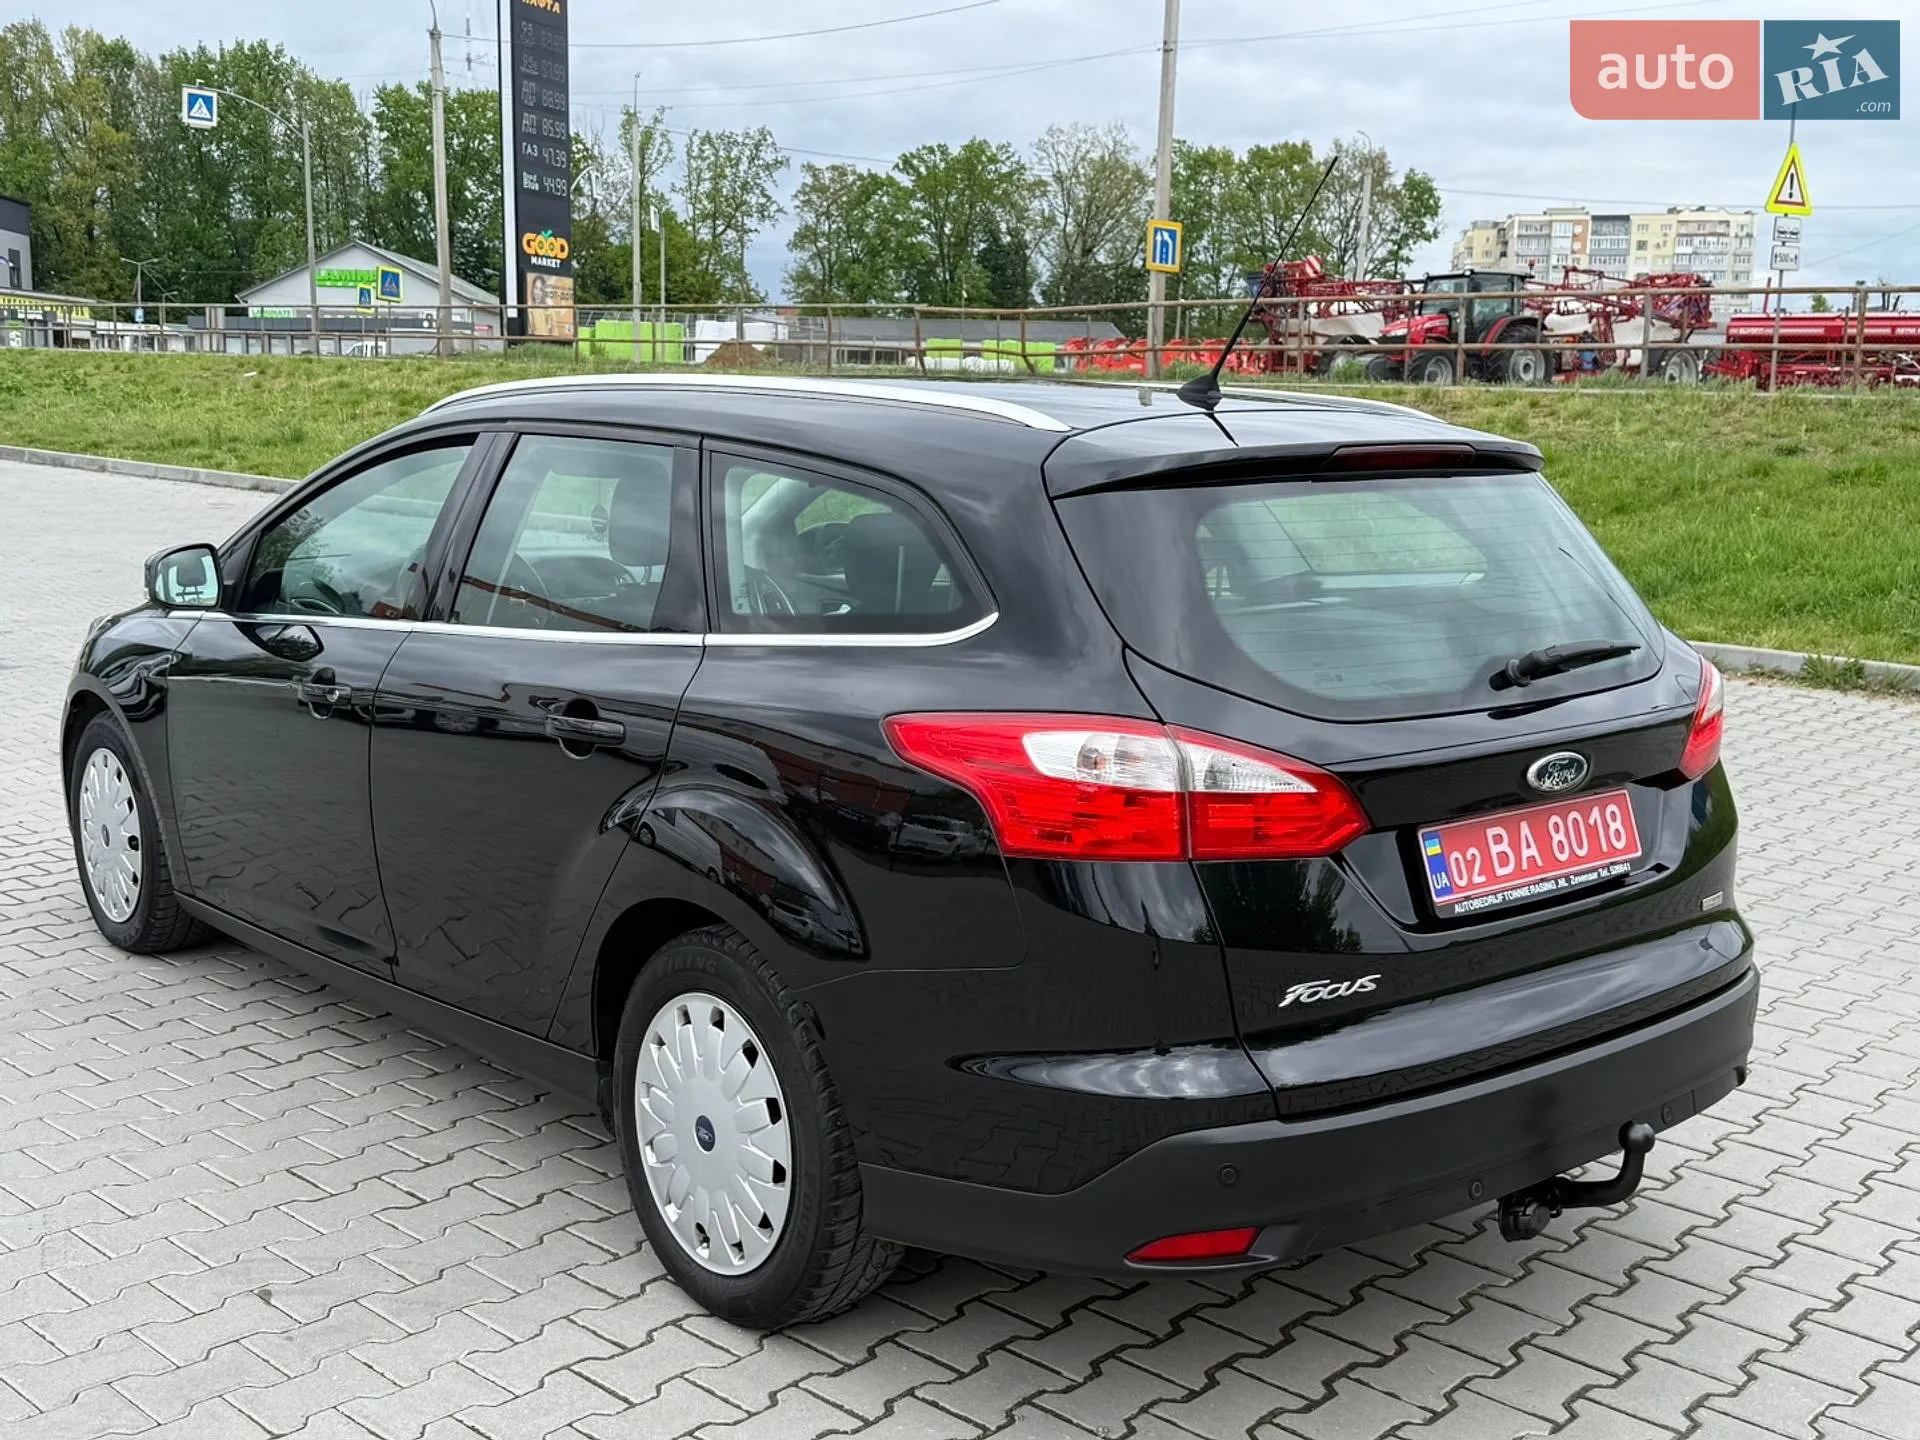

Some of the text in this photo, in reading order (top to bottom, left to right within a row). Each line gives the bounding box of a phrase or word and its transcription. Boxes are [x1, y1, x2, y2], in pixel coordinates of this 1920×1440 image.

[522, 142, 538, 157] ГАЗ
[522, 232, 569, 260] GOOD
[531, 256, 560, 268] MARKET
[1450, 803, 1627, 888] 02 BA 8018
[1433, 872, 1450, 890] UA
